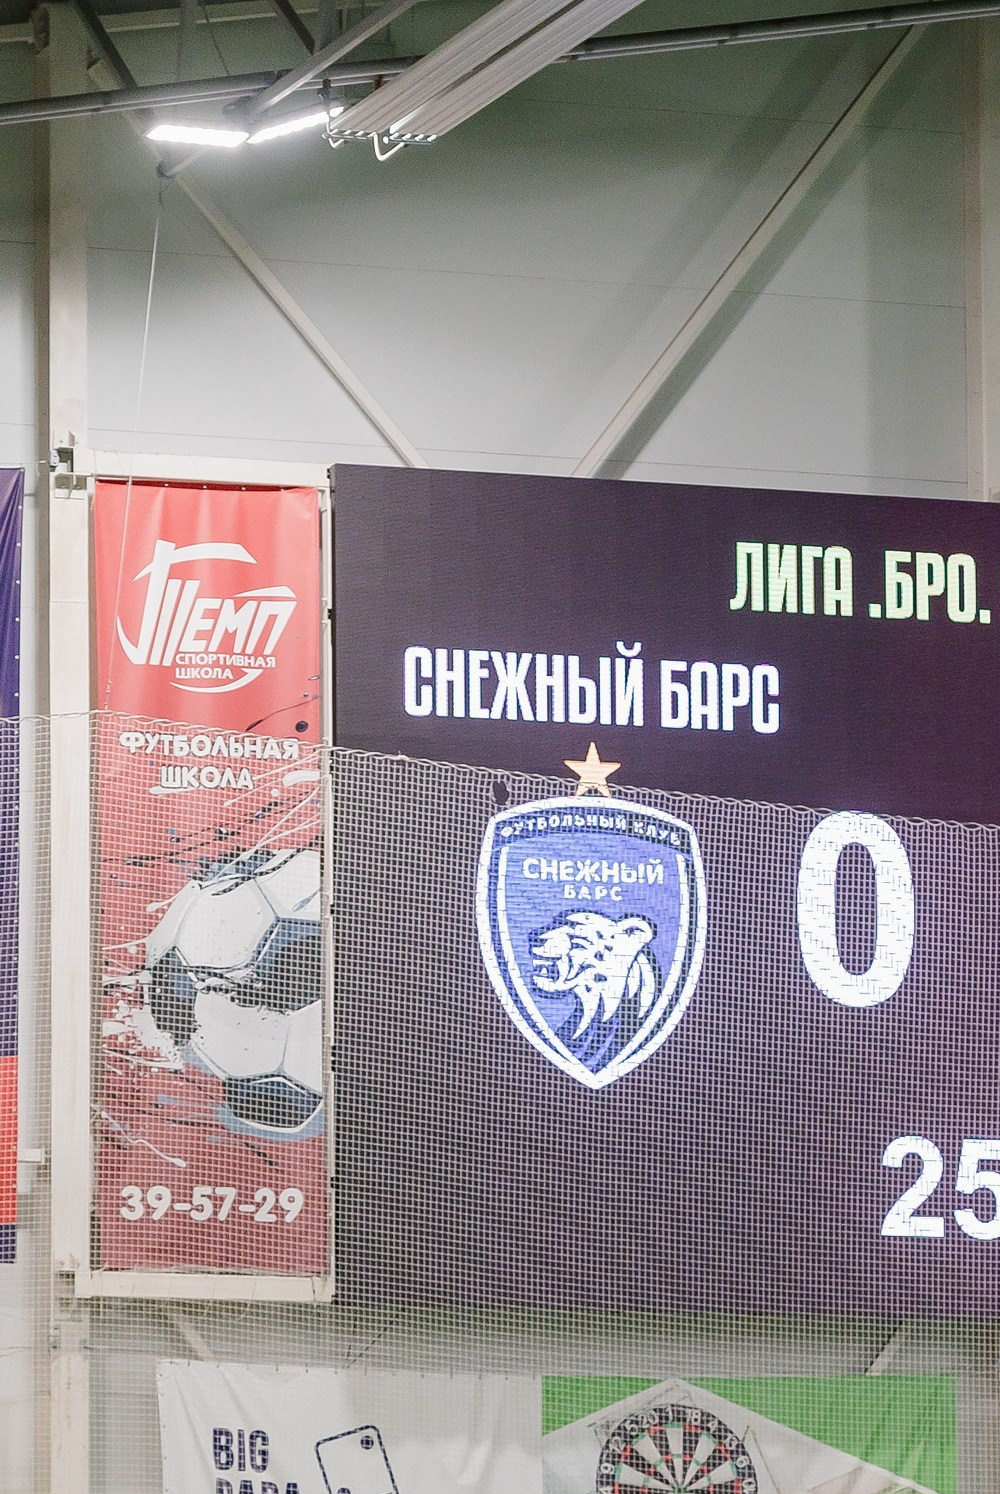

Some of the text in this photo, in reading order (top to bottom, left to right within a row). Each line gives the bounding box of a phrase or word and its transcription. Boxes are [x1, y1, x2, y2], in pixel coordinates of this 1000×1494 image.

[729, 541, 854, 617] ЛИГА
[868, 549, 991, 626] .БРО.
[116, 539, 297, 667] ТЕМП
[175, 653, 277, 669] СПОРТИВНАЯ
[175, 667, 233, 680] ШКОЛА
[403, 640, 781, 735] СНЕЖНЫЙ БАРС
[119, 731, 299, 760] ФУТБОЛЬНАЯ
[160, 765, 254, 790] ШКОЛА
[500, 814, 681, 846] ФУТБОЛЬНЫЙ КЛУБ
[522, 857, 664, 885] СНЕЖНЫЙ
[563, 883, 624, 901] БАРС
[798, 810, 915, 1008] 0
[120, 1185, 304, 1223] 39-57-29
[212, 1427, 270, 1473] BIG
